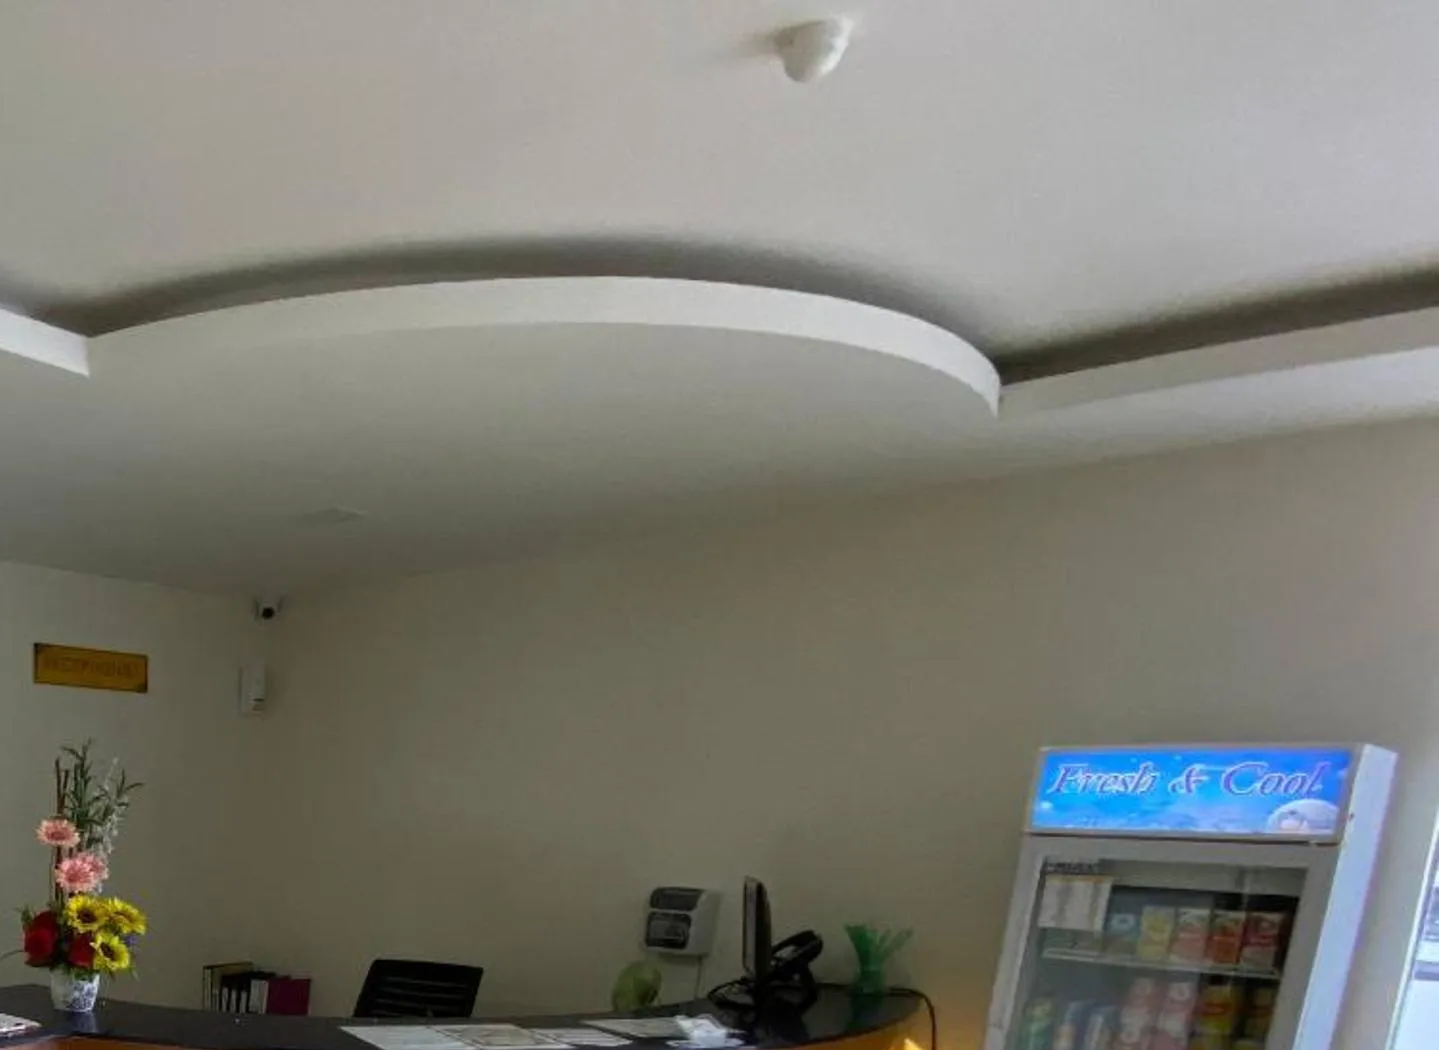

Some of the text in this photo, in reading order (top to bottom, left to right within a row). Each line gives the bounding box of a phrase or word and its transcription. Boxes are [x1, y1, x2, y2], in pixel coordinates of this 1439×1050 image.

[1046, 760, 1331, 796] Fresh & Cool
